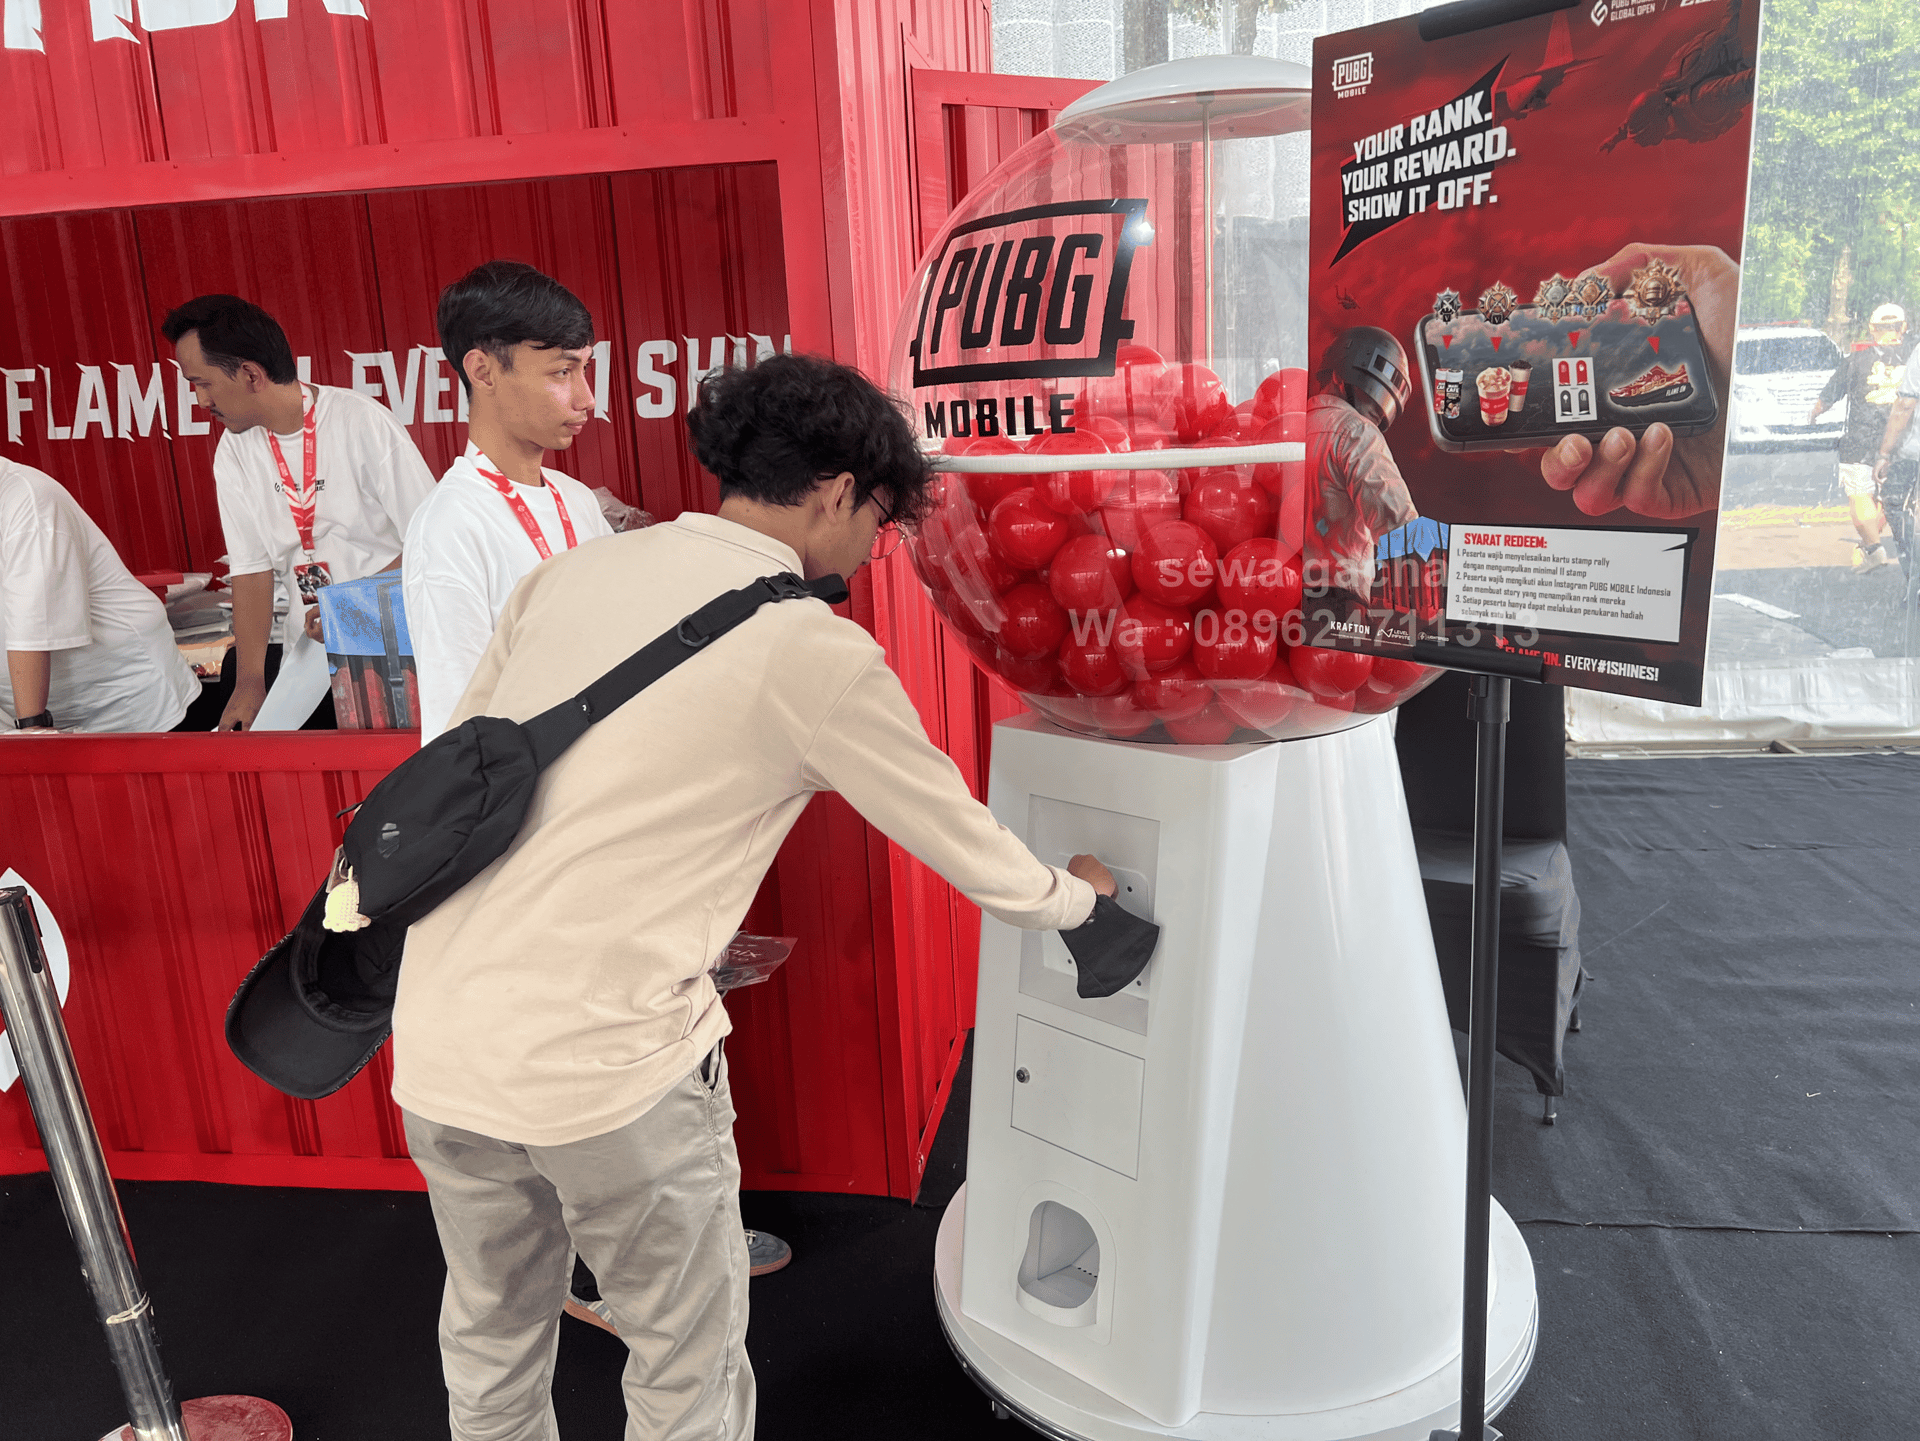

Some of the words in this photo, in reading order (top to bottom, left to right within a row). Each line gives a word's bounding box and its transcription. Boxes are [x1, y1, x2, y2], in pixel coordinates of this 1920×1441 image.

[1610, 7, 1636, 21] GLOBAL
[1637, 3, 1656, 15] OPEN
[1338, 59, 1367, 85] PUBG
[1337, 86, 1367, 99] MOBILE
[1354, 123, 1404, 164] YOUR
[1410, 90, 1492, 146] RANK.
[1342, 161, 1388, 195] YOUR
[1394, 126, 1516, 184] REWARD.
[1348, 190, 1403, 222] SHOW
[1408, 185, 1430, 214] IT
[1437, 172, 1497, 210] OFF.
[930, 233, 1104, 355] PUBG
[0, 358, 210, 446] FLAME
[924, 393, 1076, 439] MOBILE
[1464, 533, 1501, 546] SYARAT
[1504, 534, 1547, 548] REDEEM:
[1462, 549, 1485, 558] Peserta
[1487, 551, 1503, 560] wajib
[1505, 552, 1550, 562] menyelesaikan
[1552, 554, 1570, 563] kartu
[1571, 557, 1592, 567] stamp
[1594, 558, 1610, 568] rally
[1463, 561, 1484, 571] dengan
[1486, 563, 1531, 573] mengumpulkan
[1533, 566, 1558, 575] minimal
[1566, 569, 1587, 578] stamp
[1462, 584, 1473, 592] dan
[1474, 586, 1502, 595] membuat
[1503, 589, 1520, 598] story
[1522, 591, 1537, 599] yang
[1538, 592, 1580, 602] menampilkan
[1582, 595, 1598, 603] rank
[1599, 597, 1626, 606] mereka
[1463, 572, 1487, 582] Peserta
[1488, 574, 1504, 584] wajib
[1505, 577, 1536, 586] mengikuti
[1537, 579, 1553, 587] akun
[1554, 579, 1587, 590] Instagram
[1589, 582, 1608, 592] PUBG
[1610, 583, 1635, 594] MOBILE
[1637, 585, 1671, 597] Indonesia
[1462, 595, 1481, 605] Setiap
[1483, 598, 1506, 607] peserta
[1508, 600, 1526, 610] hanya
[1528, 601, 1546, 611] dapat
[1547, 604, 1581, 614] melakukan
[1583, 608, 1619, 618] penukaran
[1620, 609, 1644, 620] hadiah
[1505, 611, 1516, 620] kali
[1330, 621, 1371, 635] KRAFTON
[1543, 651, 1561, 667] ON.
[1565, 654, 1659, 682] EVERY#1SHINES!
